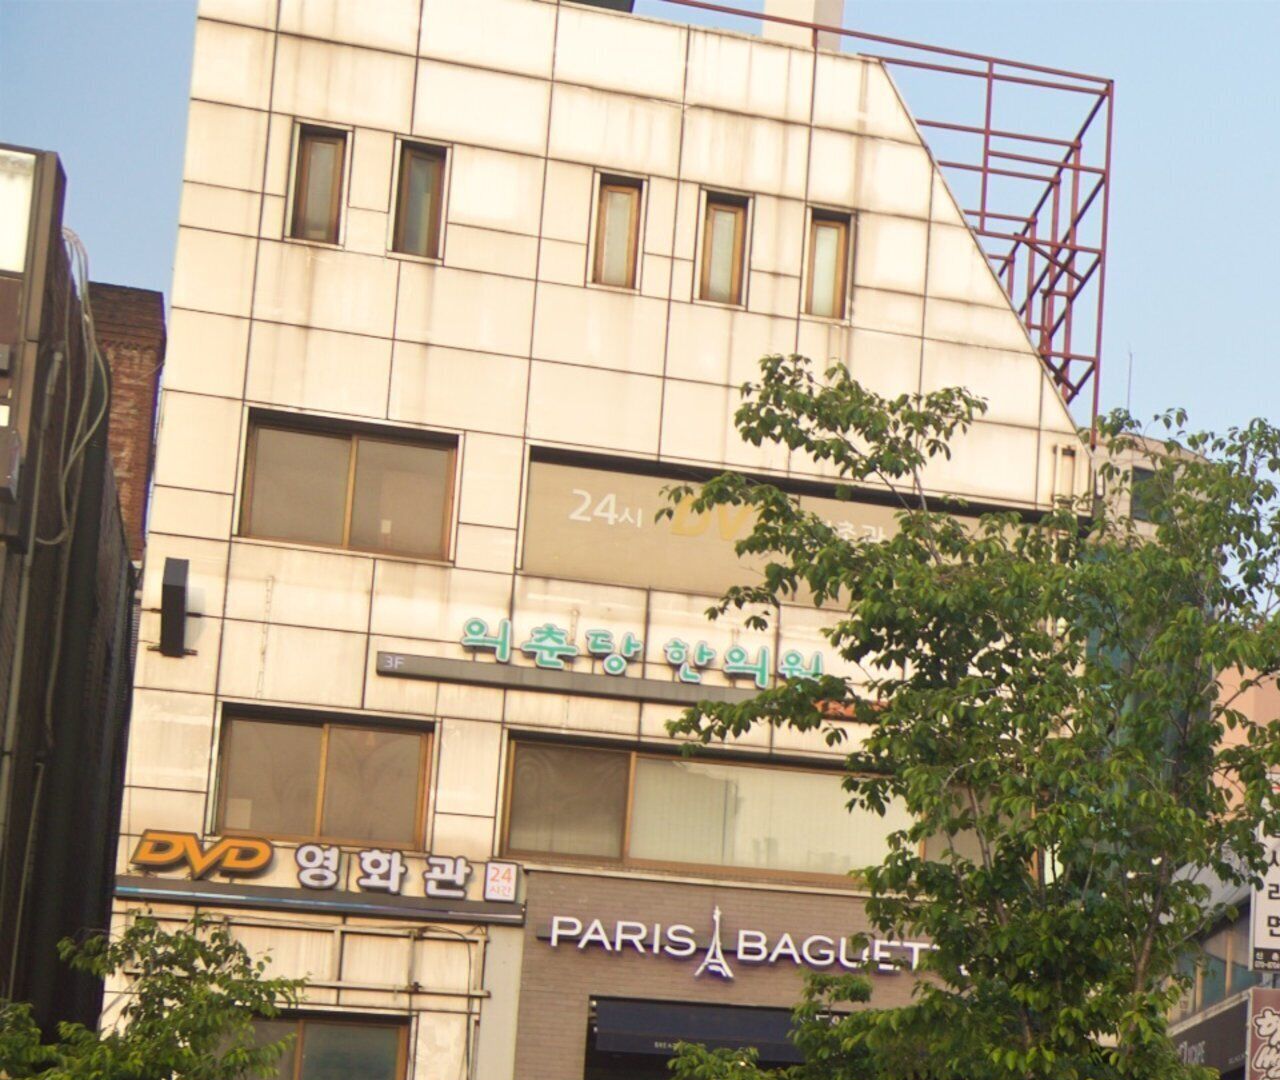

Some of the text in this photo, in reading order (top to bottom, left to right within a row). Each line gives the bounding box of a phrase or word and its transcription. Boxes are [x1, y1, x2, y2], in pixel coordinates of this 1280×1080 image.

[569, 488, 642, 529] 24시
[131, 830, 473, 899] DVD 영화관
[489, 866, 513, 883] 24
[550, 915, 697, 957] PARIS
